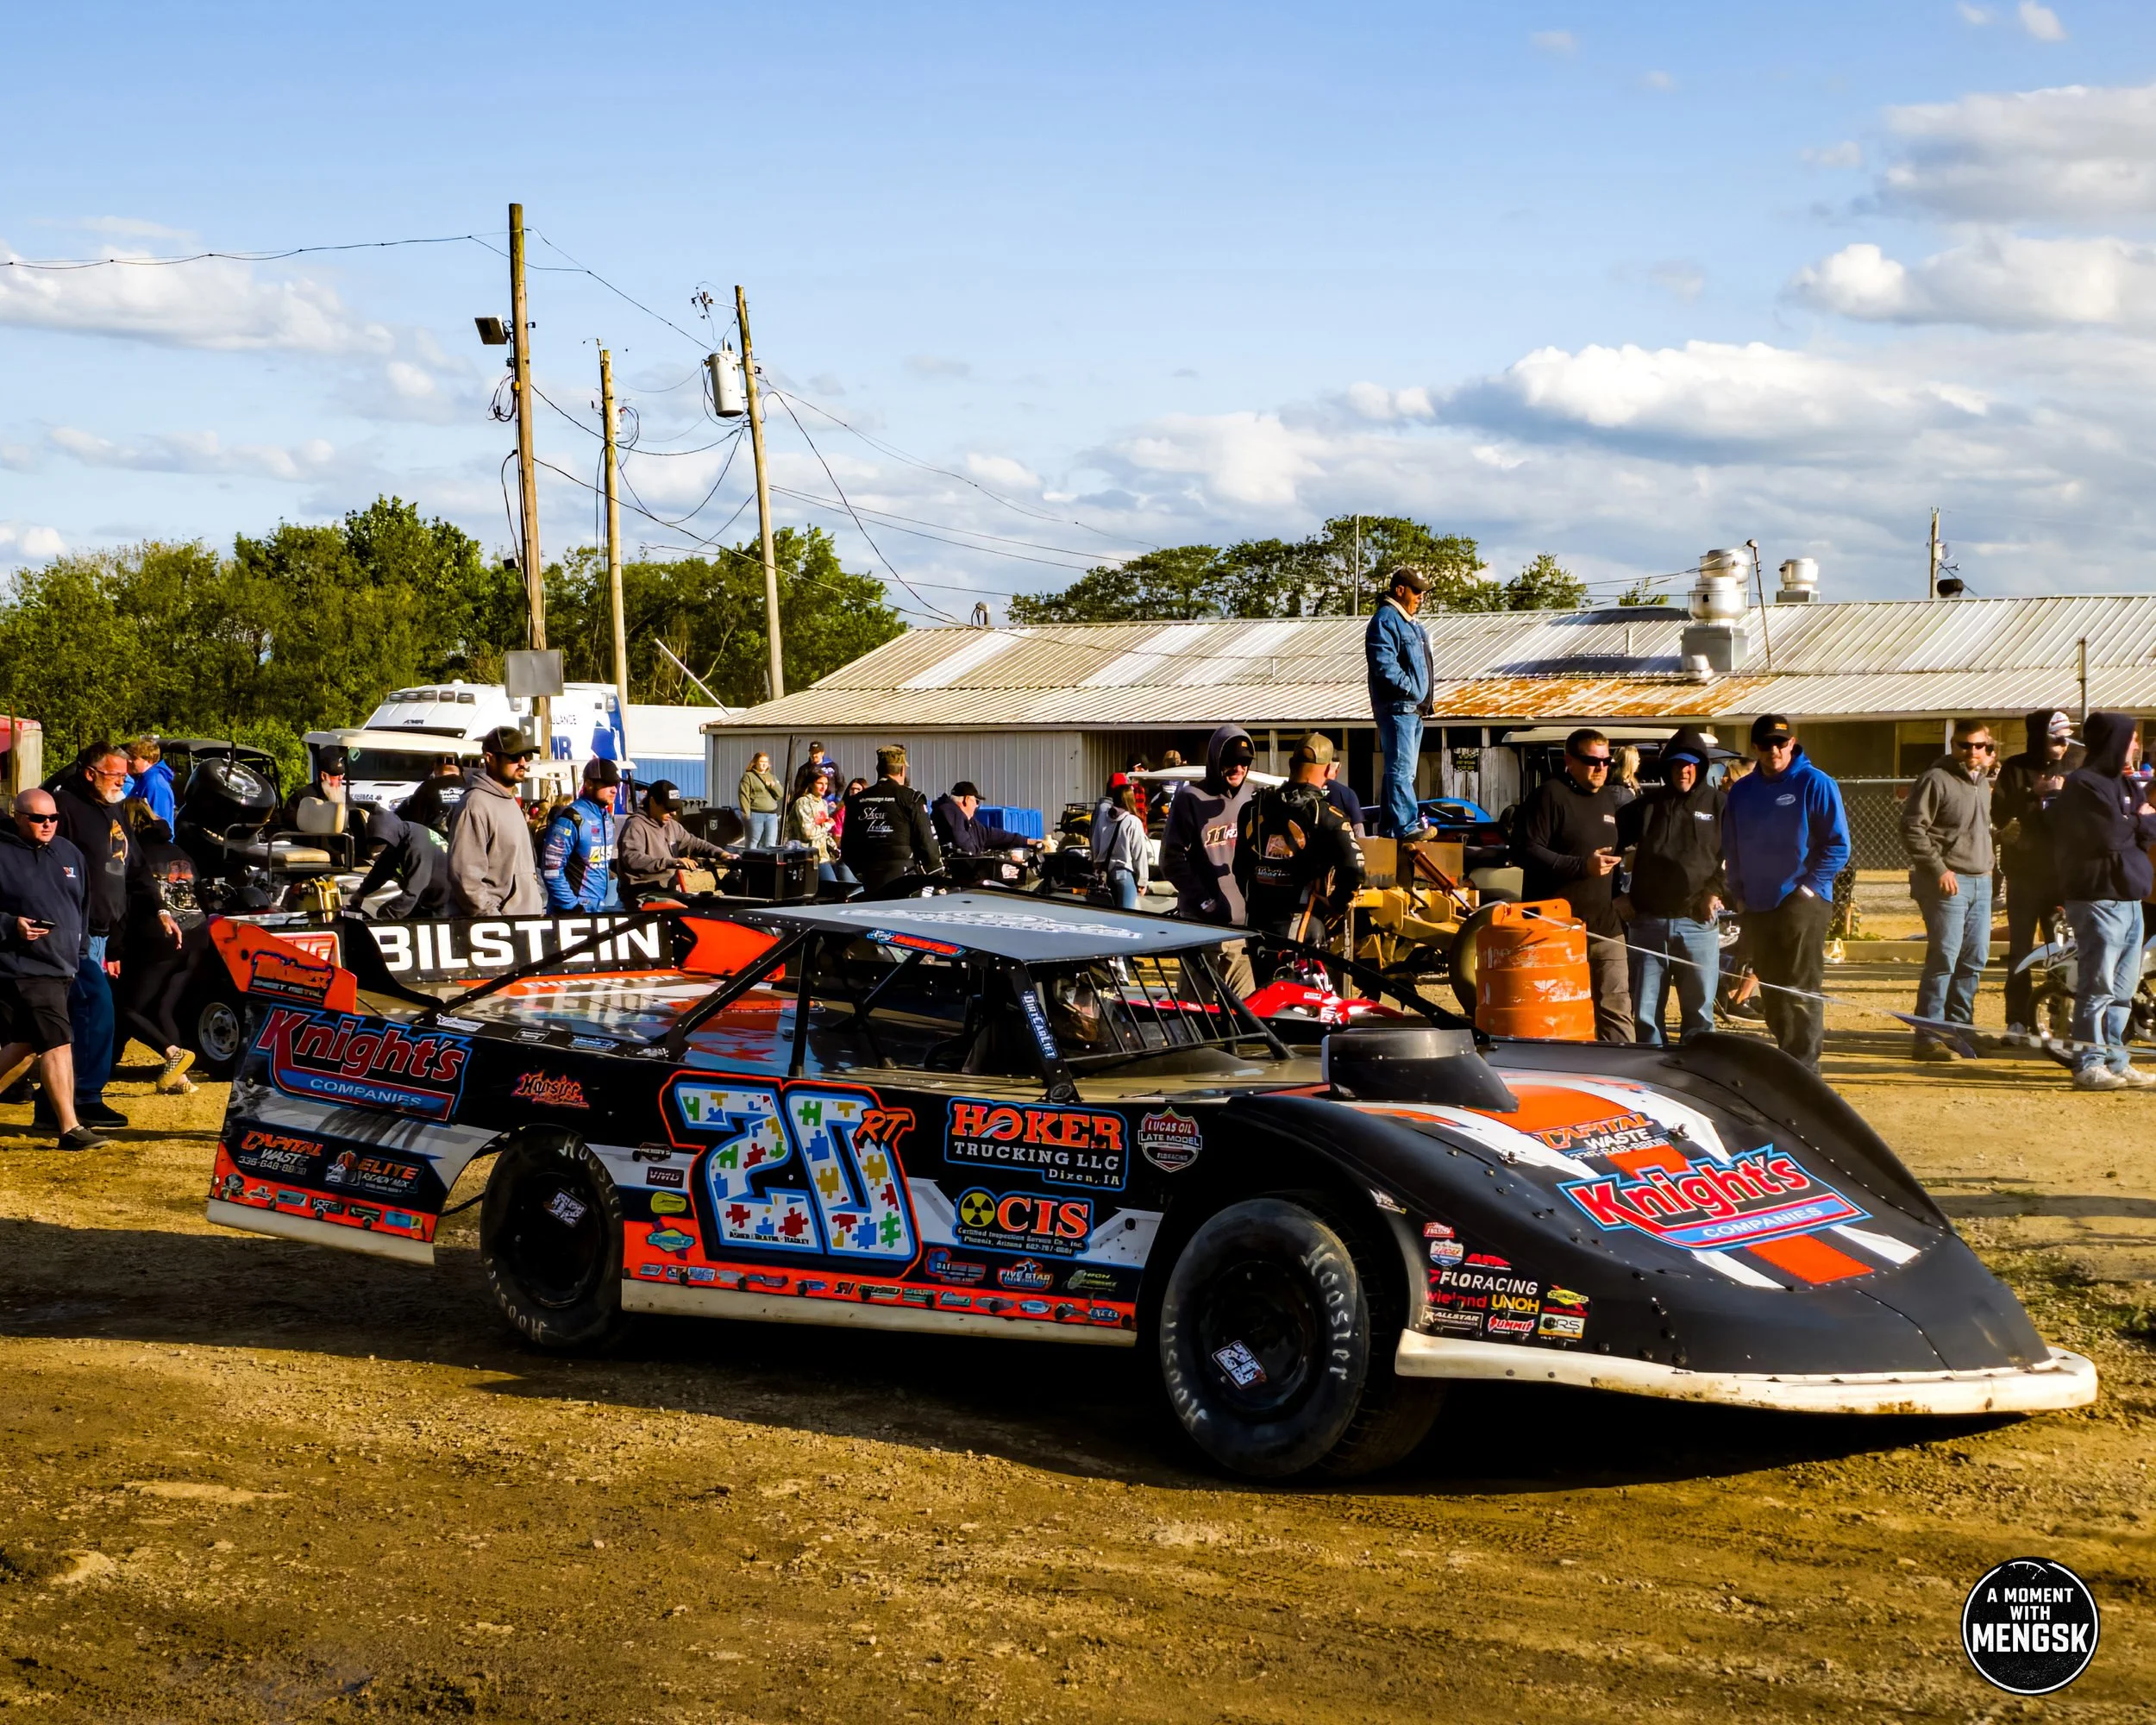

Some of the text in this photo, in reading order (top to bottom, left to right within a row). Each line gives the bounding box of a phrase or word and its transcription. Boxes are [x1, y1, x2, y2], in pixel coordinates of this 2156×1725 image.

[369, 917, 661, 972] BILSTEIN
[257, 1010, 465, 1082] Knight's
[310, 1078, 423, 1107] COMPANIES
[856, 1110, 909, 1142] RT
[951, 1103, 1123, 1151] HOKER
[1140, 1132, 1164, 1142] LATE
[1166, 1134, 1200, 1147] MODEL
[1148, 1120, 1192, 1134] LUCAS OIL
[1538, 1113, 1654, 1151] CAPITAL
[1584, 1128, 1652, 1150] WASTE
[241, 1129, 324, 1157] CAPITAL
[260, 1148, 310, 1165] WASTE
[954, 1141, 1069, 1165] TRUCKING
[358, 1157, 420, 1180] ELITE
[1570, 1154, 1811, 1227] Knight's
[997, 1196, 1088, 1239] CIS
[1702, 1207, 1823, 1239] COMPANIES
[1439, 1270, 1539, 1295] FLORACING
[1435, 1311, 1480, 1321] ALLSTAR
[1492, 1294, 1540, 1313] UNOH
